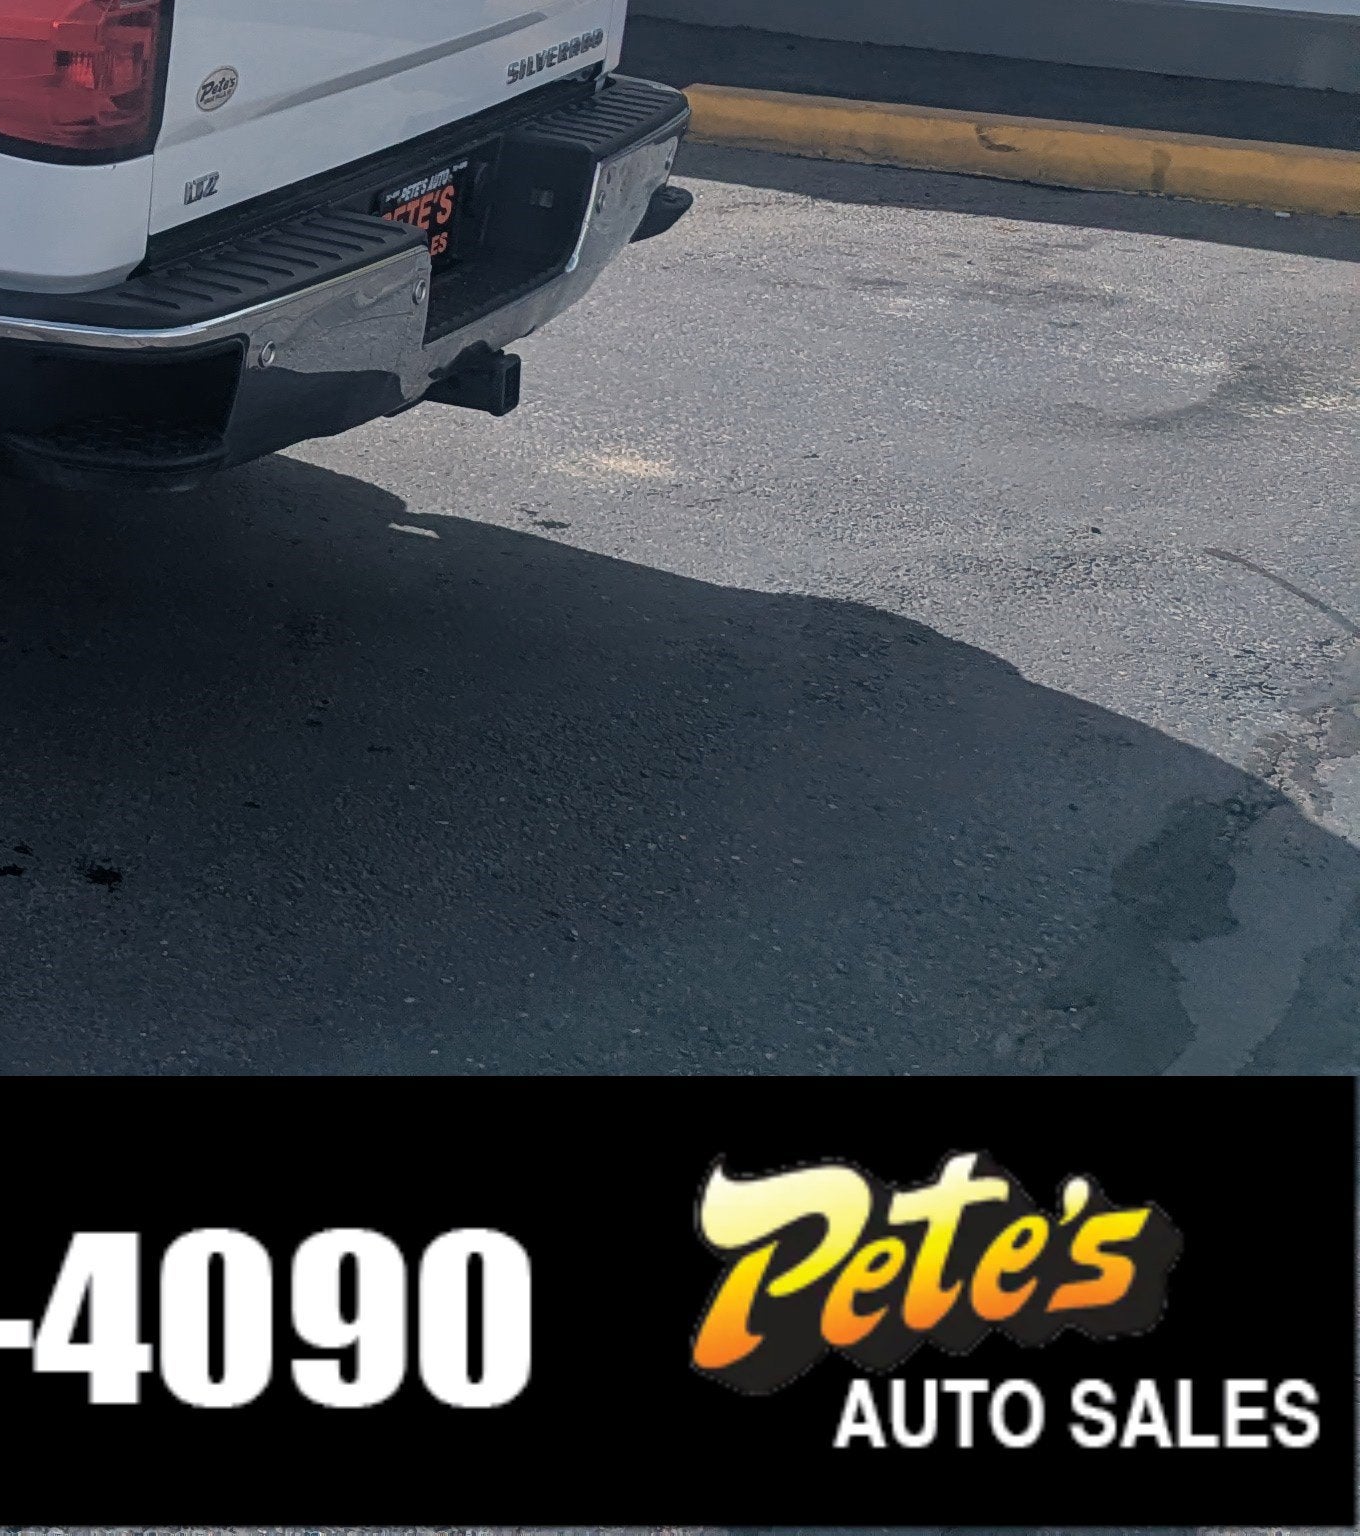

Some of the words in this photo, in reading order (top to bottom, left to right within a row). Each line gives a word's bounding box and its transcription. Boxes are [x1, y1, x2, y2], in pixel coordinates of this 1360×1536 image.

[506, 28, 603, 84] SILVERADO
[184, 171, 219, 205] LTZ
[382, 185, 454, 230] ETE'S
